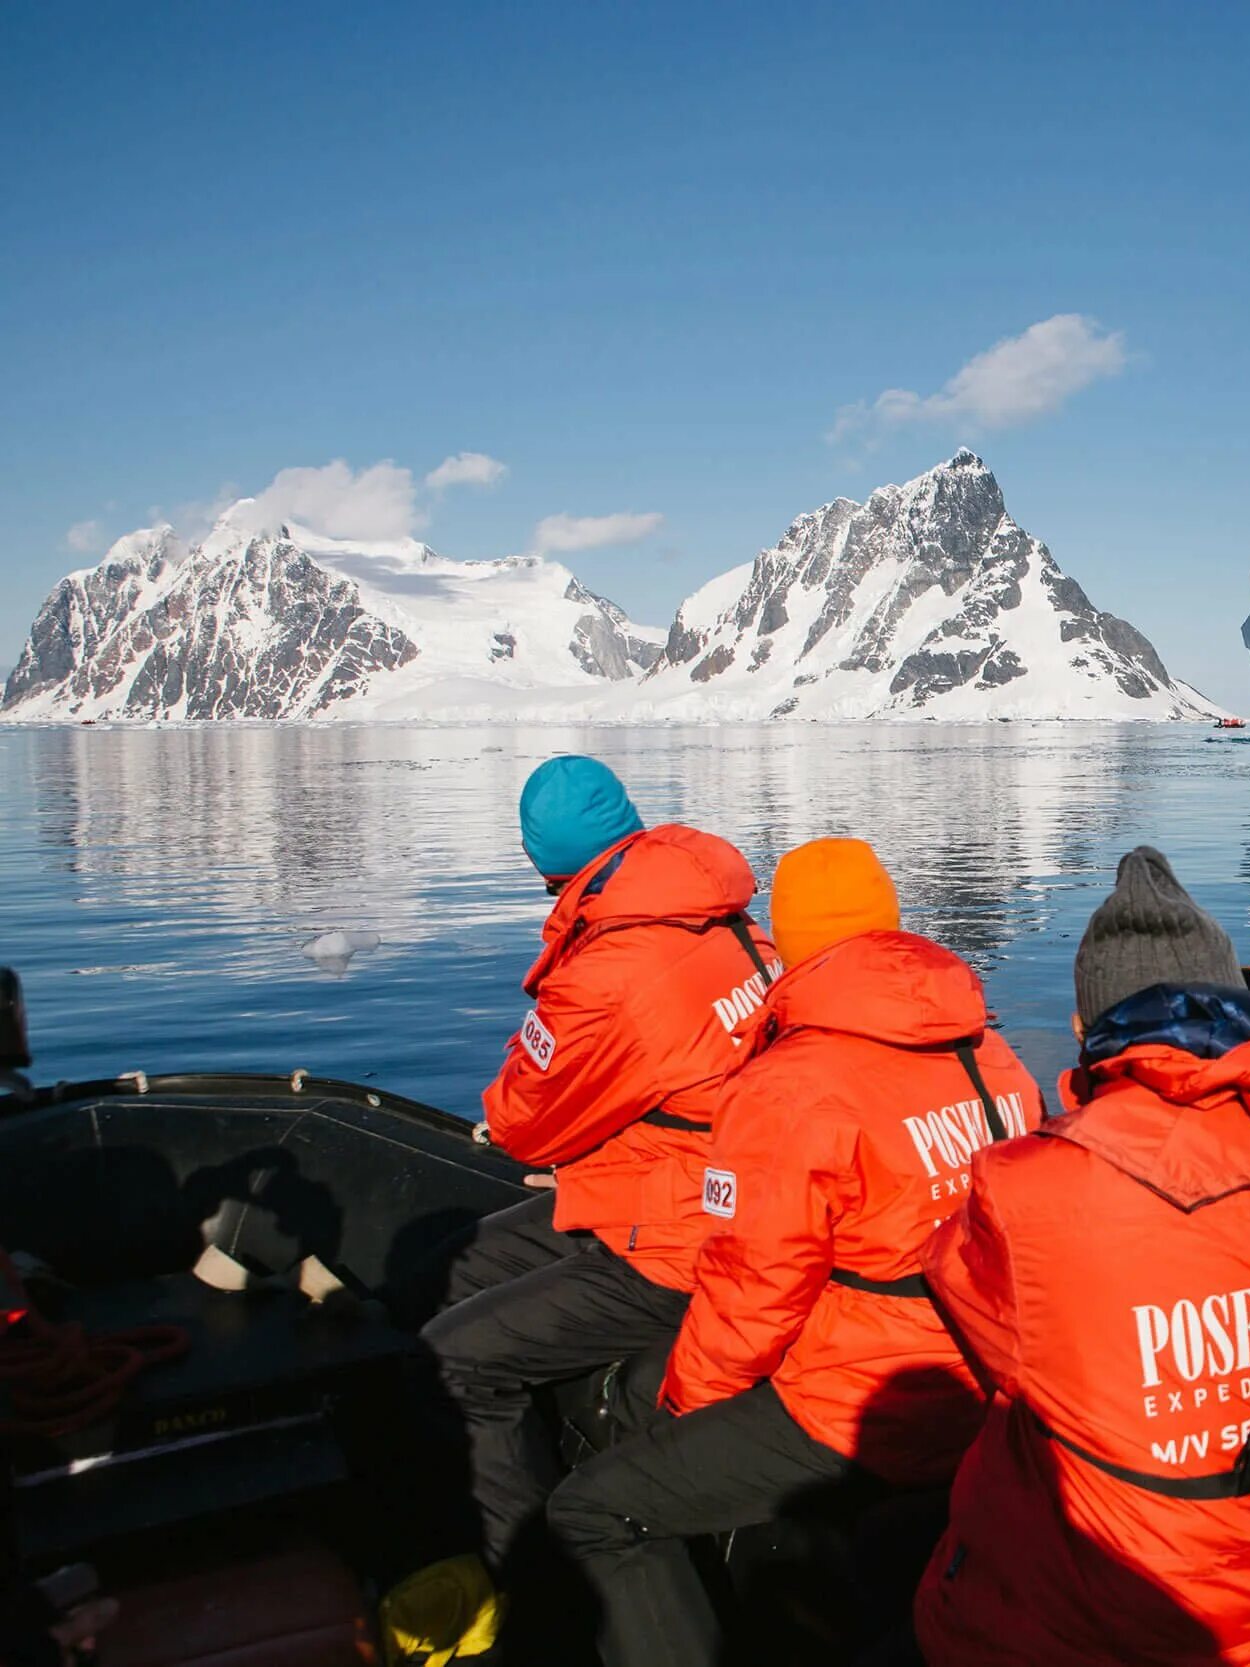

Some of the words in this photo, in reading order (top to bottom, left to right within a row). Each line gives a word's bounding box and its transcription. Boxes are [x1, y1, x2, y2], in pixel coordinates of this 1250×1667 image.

[525, 1021, 551, 1060] 085
[706, 1178, 733, 1208] 092
[1151, 1430, 1209, 1464] M/V
